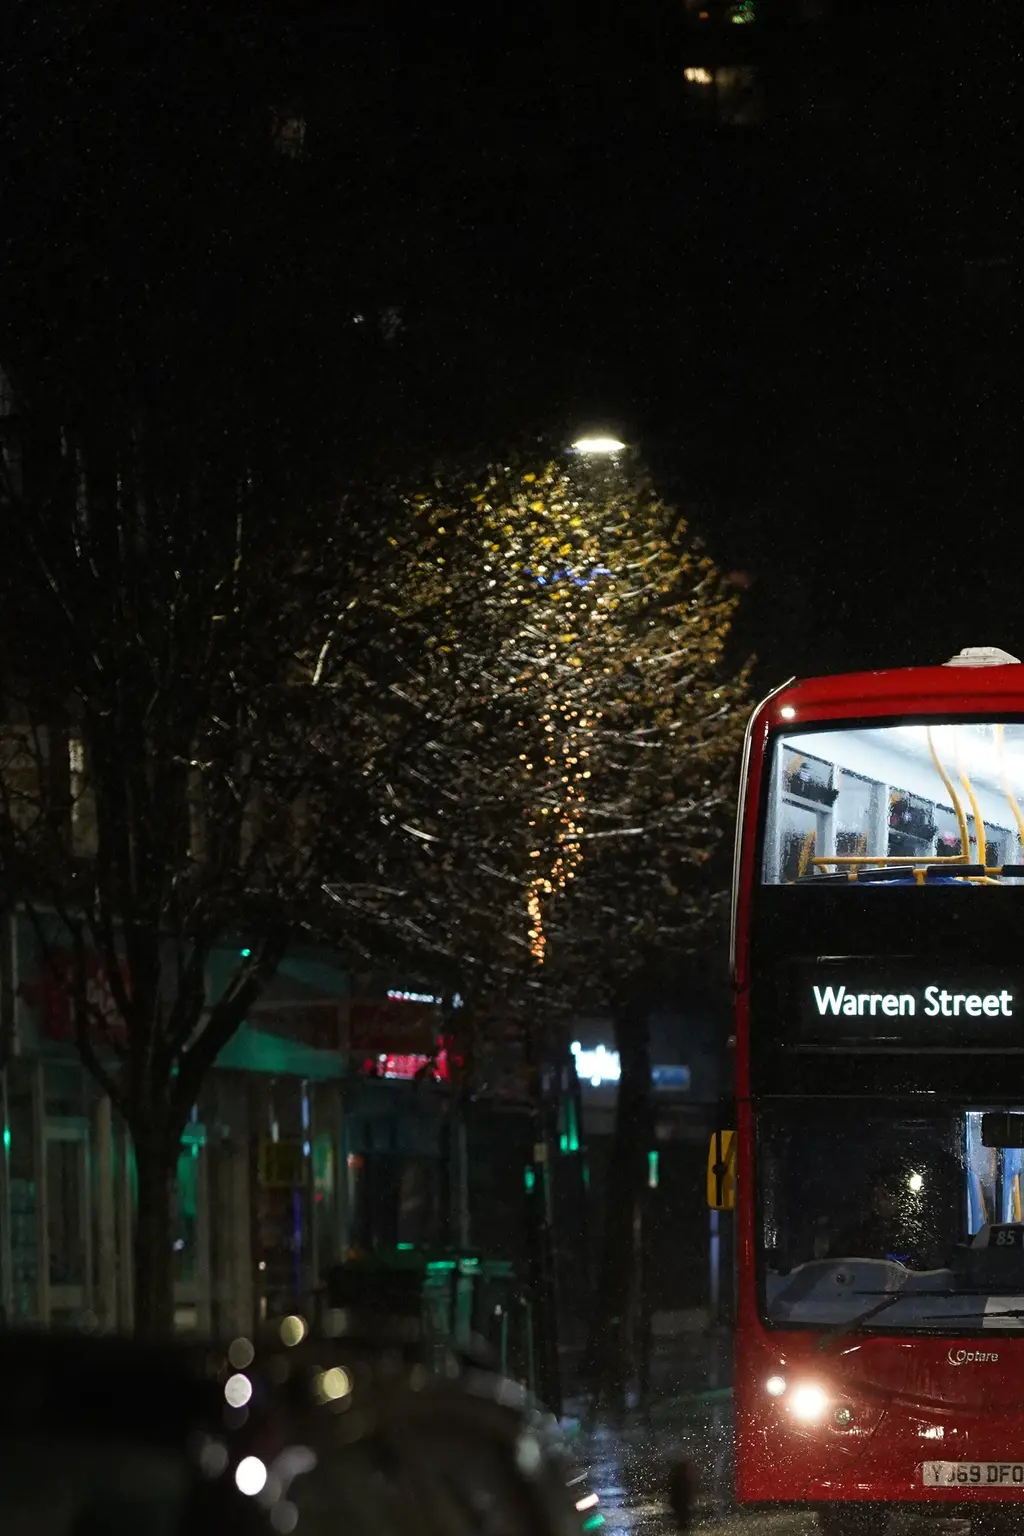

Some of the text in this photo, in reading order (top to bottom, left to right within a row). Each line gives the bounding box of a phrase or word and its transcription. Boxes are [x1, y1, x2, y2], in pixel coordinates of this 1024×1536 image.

[812, 985, 1014, 1017] Warren Street
[995, 1229, 1018, 1246] 85
[954, 1349, 999, 1365] Optare
[931, 1465, 1024, 1483] YJ69 DFO
